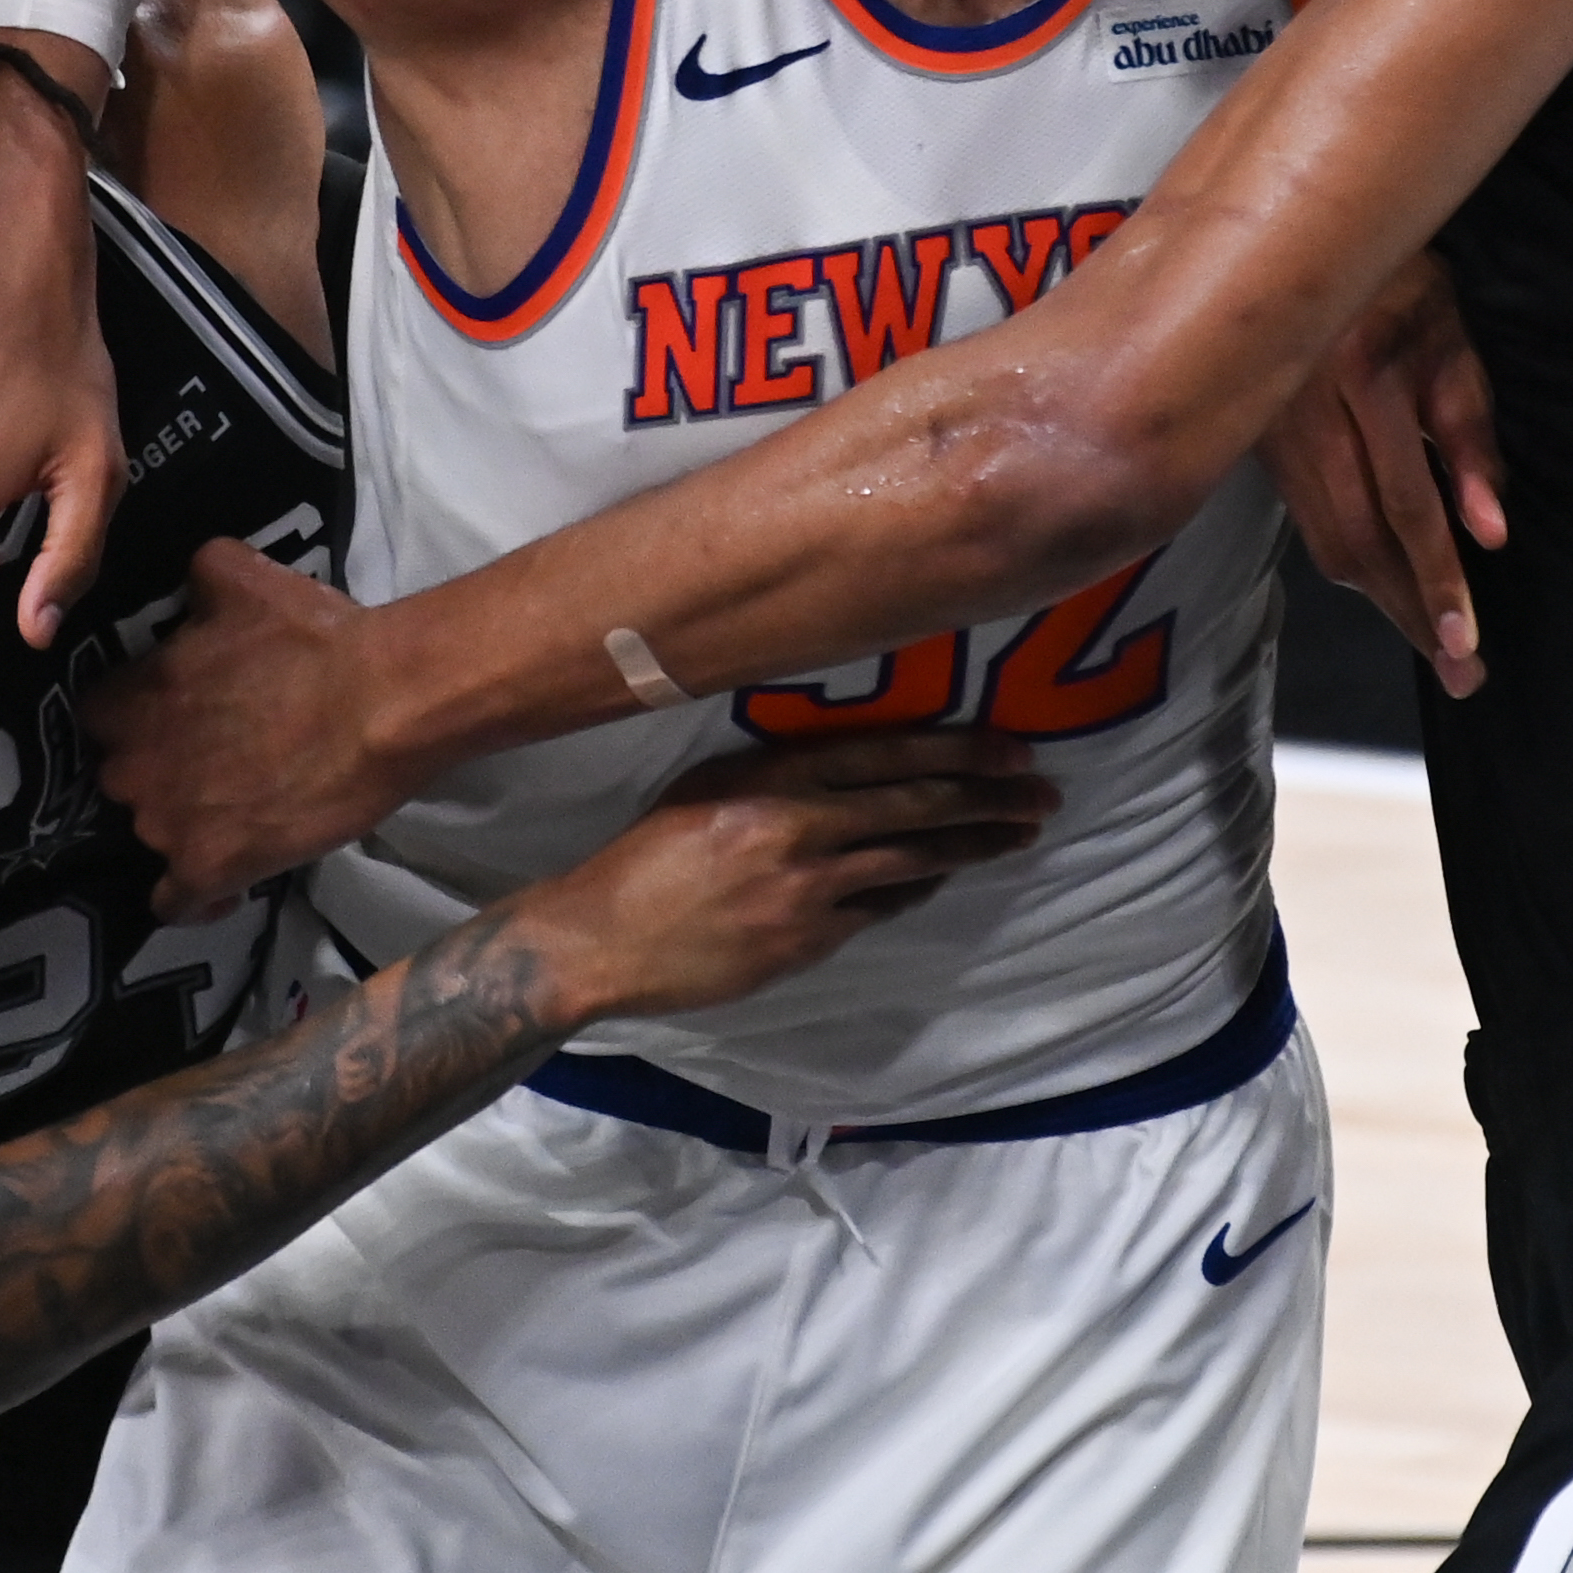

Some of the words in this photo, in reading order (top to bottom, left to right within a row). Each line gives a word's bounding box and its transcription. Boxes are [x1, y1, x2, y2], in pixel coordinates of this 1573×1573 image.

[1111, 13, 1200, 36] experience
[1114, 37, 1179, 70] abu
[1182, 20, 1274, 62] dhabi
[624, 236, 956, 429] NEW
[126, 409, 203, 485] DGER
